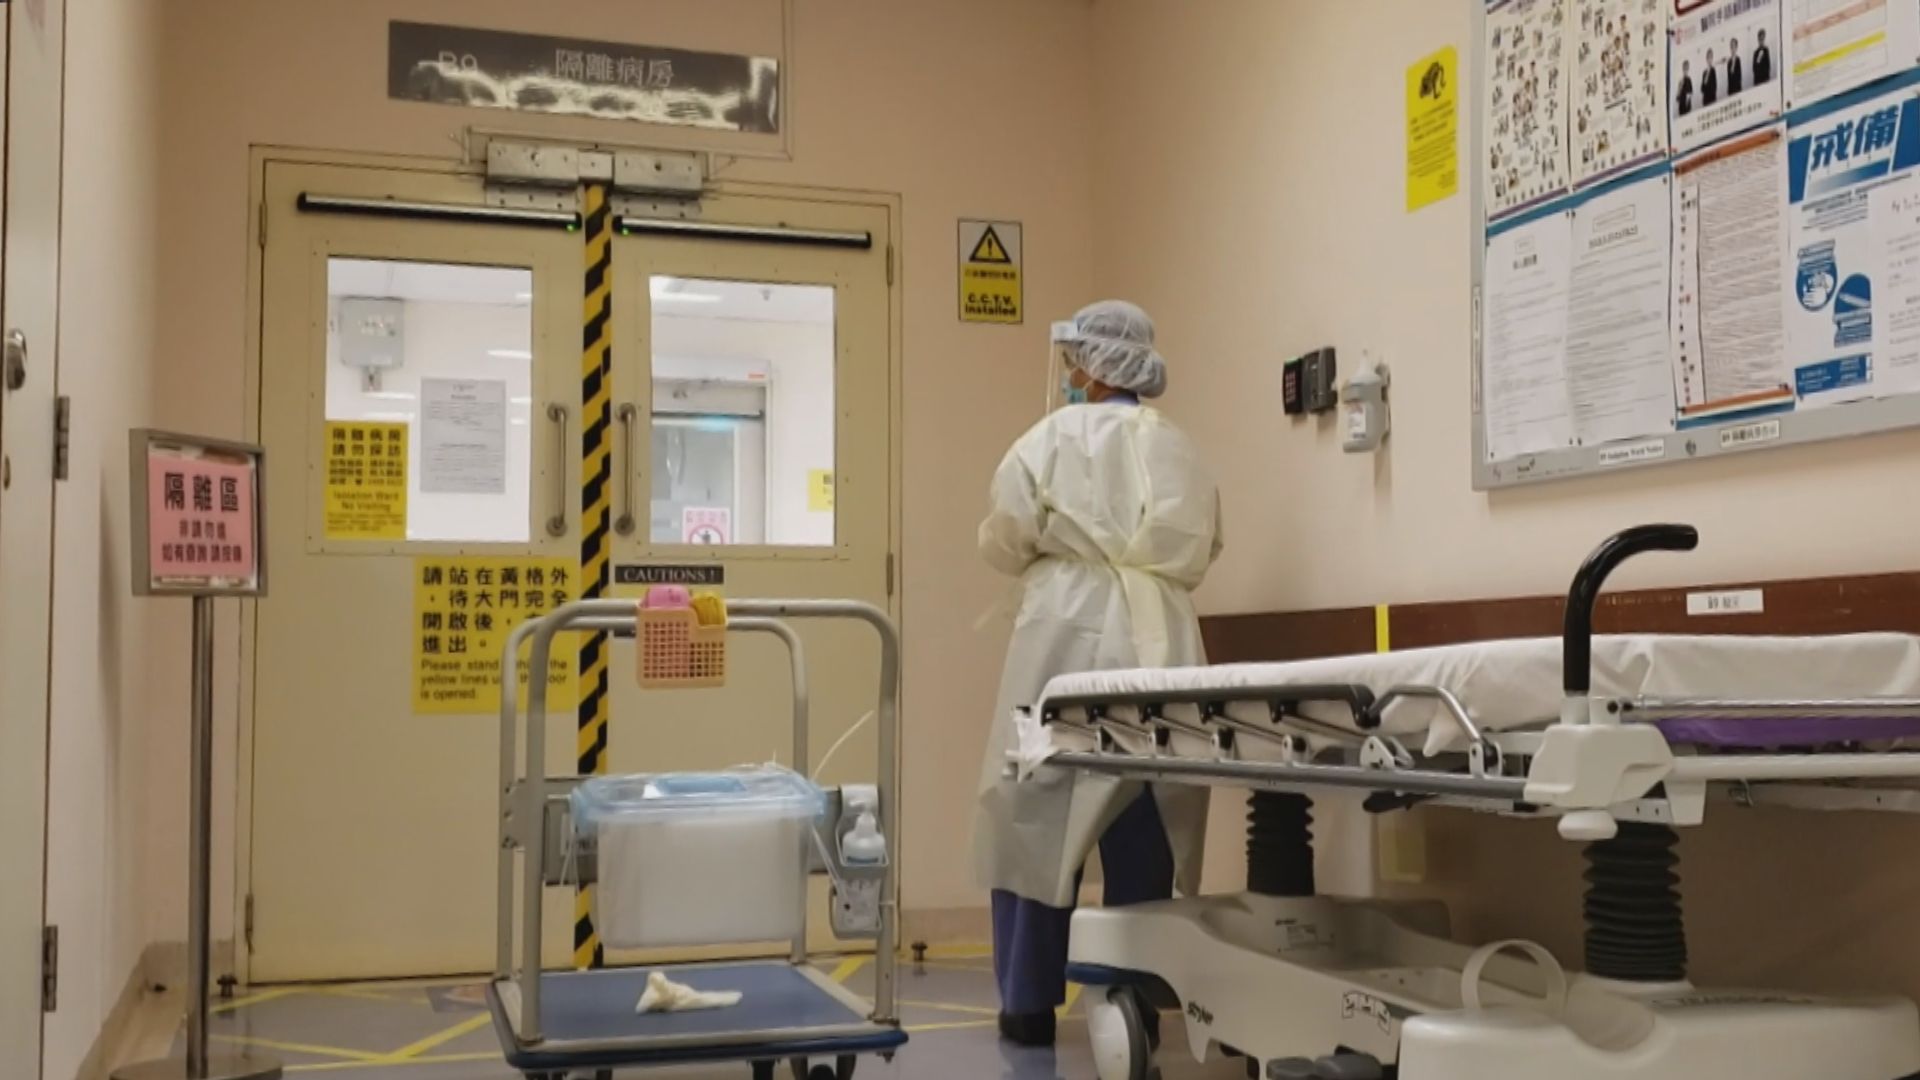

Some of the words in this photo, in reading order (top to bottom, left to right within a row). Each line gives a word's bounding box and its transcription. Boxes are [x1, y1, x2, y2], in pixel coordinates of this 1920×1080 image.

[556, 50, 674, 87] 隔離病房
[164, 471, 239, 512] 隔離區
[423, 566, 568, 585] 請站在黃格外
[624, 568, 706, 581] CAUTIONS
[421, 658, 461, 670] Please
[467, 659, 499, 670] stand
[421, 675, 457, 686] yellow
[461, 674, 488, 684] lines
[548, 675, 567, 684] oor
[421, 690, 430, 699] is
